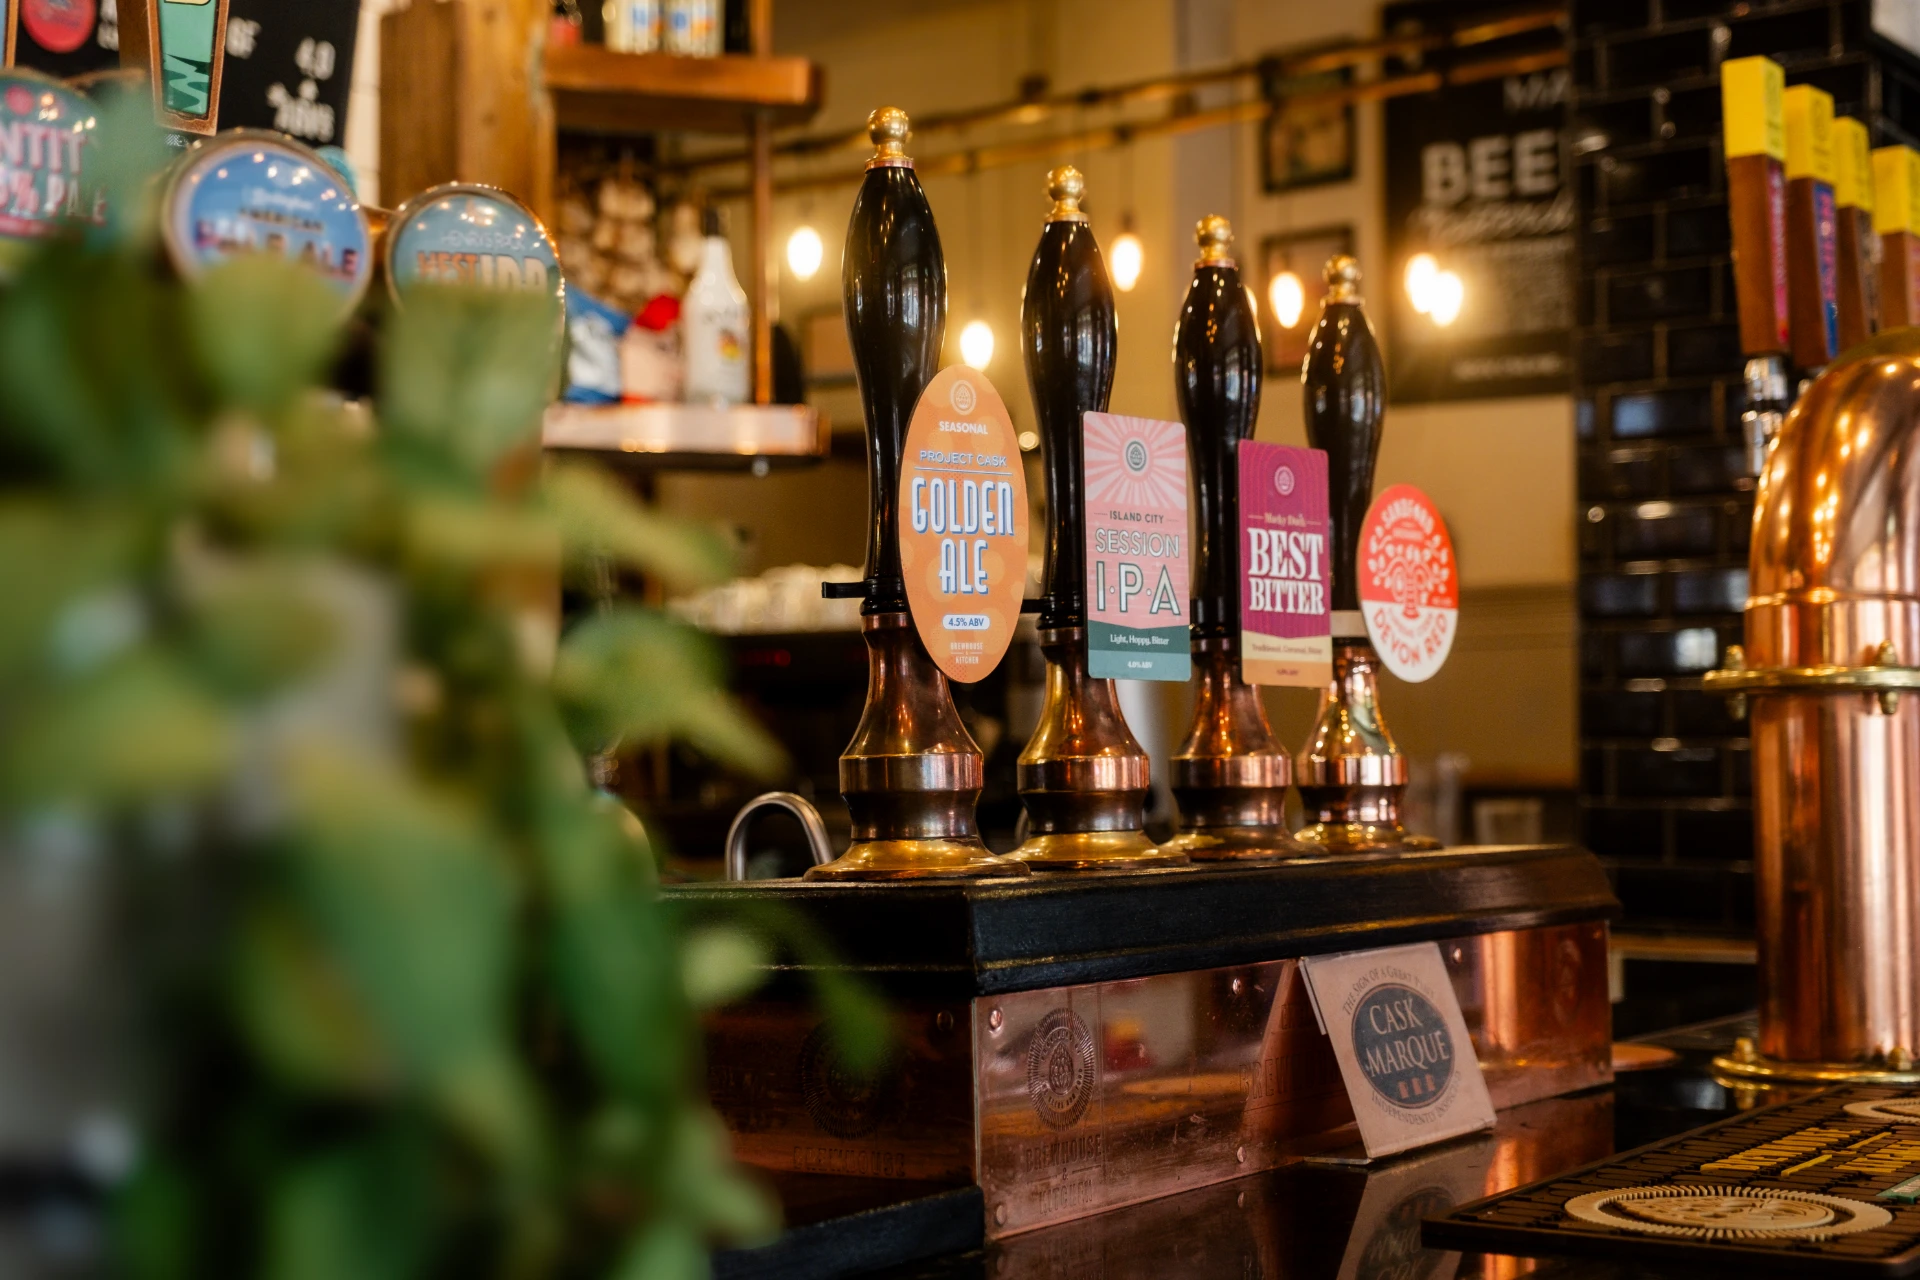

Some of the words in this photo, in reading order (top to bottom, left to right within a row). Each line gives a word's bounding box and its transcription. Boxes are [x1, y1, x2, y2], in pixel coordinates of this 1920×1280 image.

[938, 420, 989, 435] SEASONAL
[919, 450, 974, 465] PROJECT
[976, 454, 1008, 467] CASK
[911, 476, 1015, 536] GOLDEN
[1109, 510, 1142, 522] ISLAND
[1144, 513, 1164, 524] CITY
[1095, 527, 1180, 559] SESSION
[1246, 527, 1324, 581] BEST
[938, 538, 989, 595] ALE
[1248, 577, 1326, 616] BITTER
[948, 617, 968, 627] 4.5%
[968, 617, 985, 628] ABV
[1110, 633, 1129, 645] Light,
[1129, 634, 1152, 646] Hoppy,
[1151, 635, 1170, 646] Bitter
[1373, 607, 1422, 668] DEVON
[1423, 612, 1448, 658] RED
[950, 642, 983, 651] BREWHOUSE
[955, 656, 979, 665] KITCHEN
[1342, 991, 1356, 1015] THE
[1352, 973, 1370, 997] SIGN
[1369, 967, 1380, 982] OF
[1369, 995, 1423, 1036] CASK
[1365, 1030, 1450, 1078] MARQUE
[1025, 1133, 1102, 1173] BREWHOUSE
